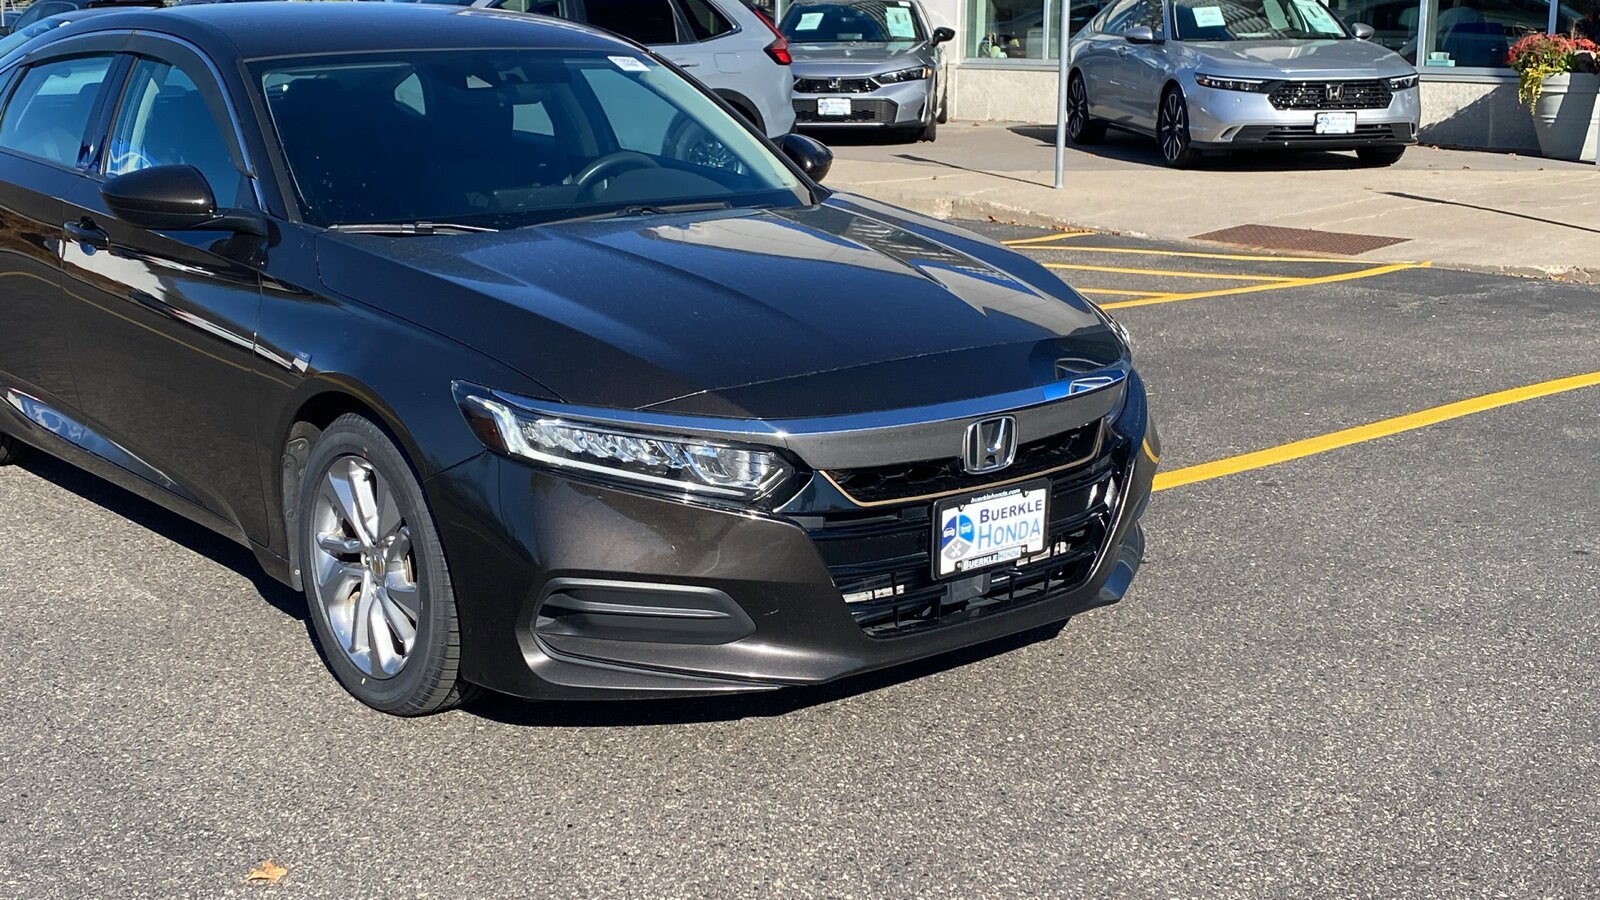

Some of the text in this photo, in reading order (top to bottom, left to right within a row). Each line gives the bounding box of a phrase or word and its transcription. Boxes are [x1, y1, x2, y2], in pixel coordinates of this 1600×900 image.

[970, 488, 1021, 503] buerklehonda.com
[980, 499, 1042, 524] BUERKLE
[978, 518, 1041, 549] HONDA
[962, 548, 1020, 570] BUERKLE HONDA
